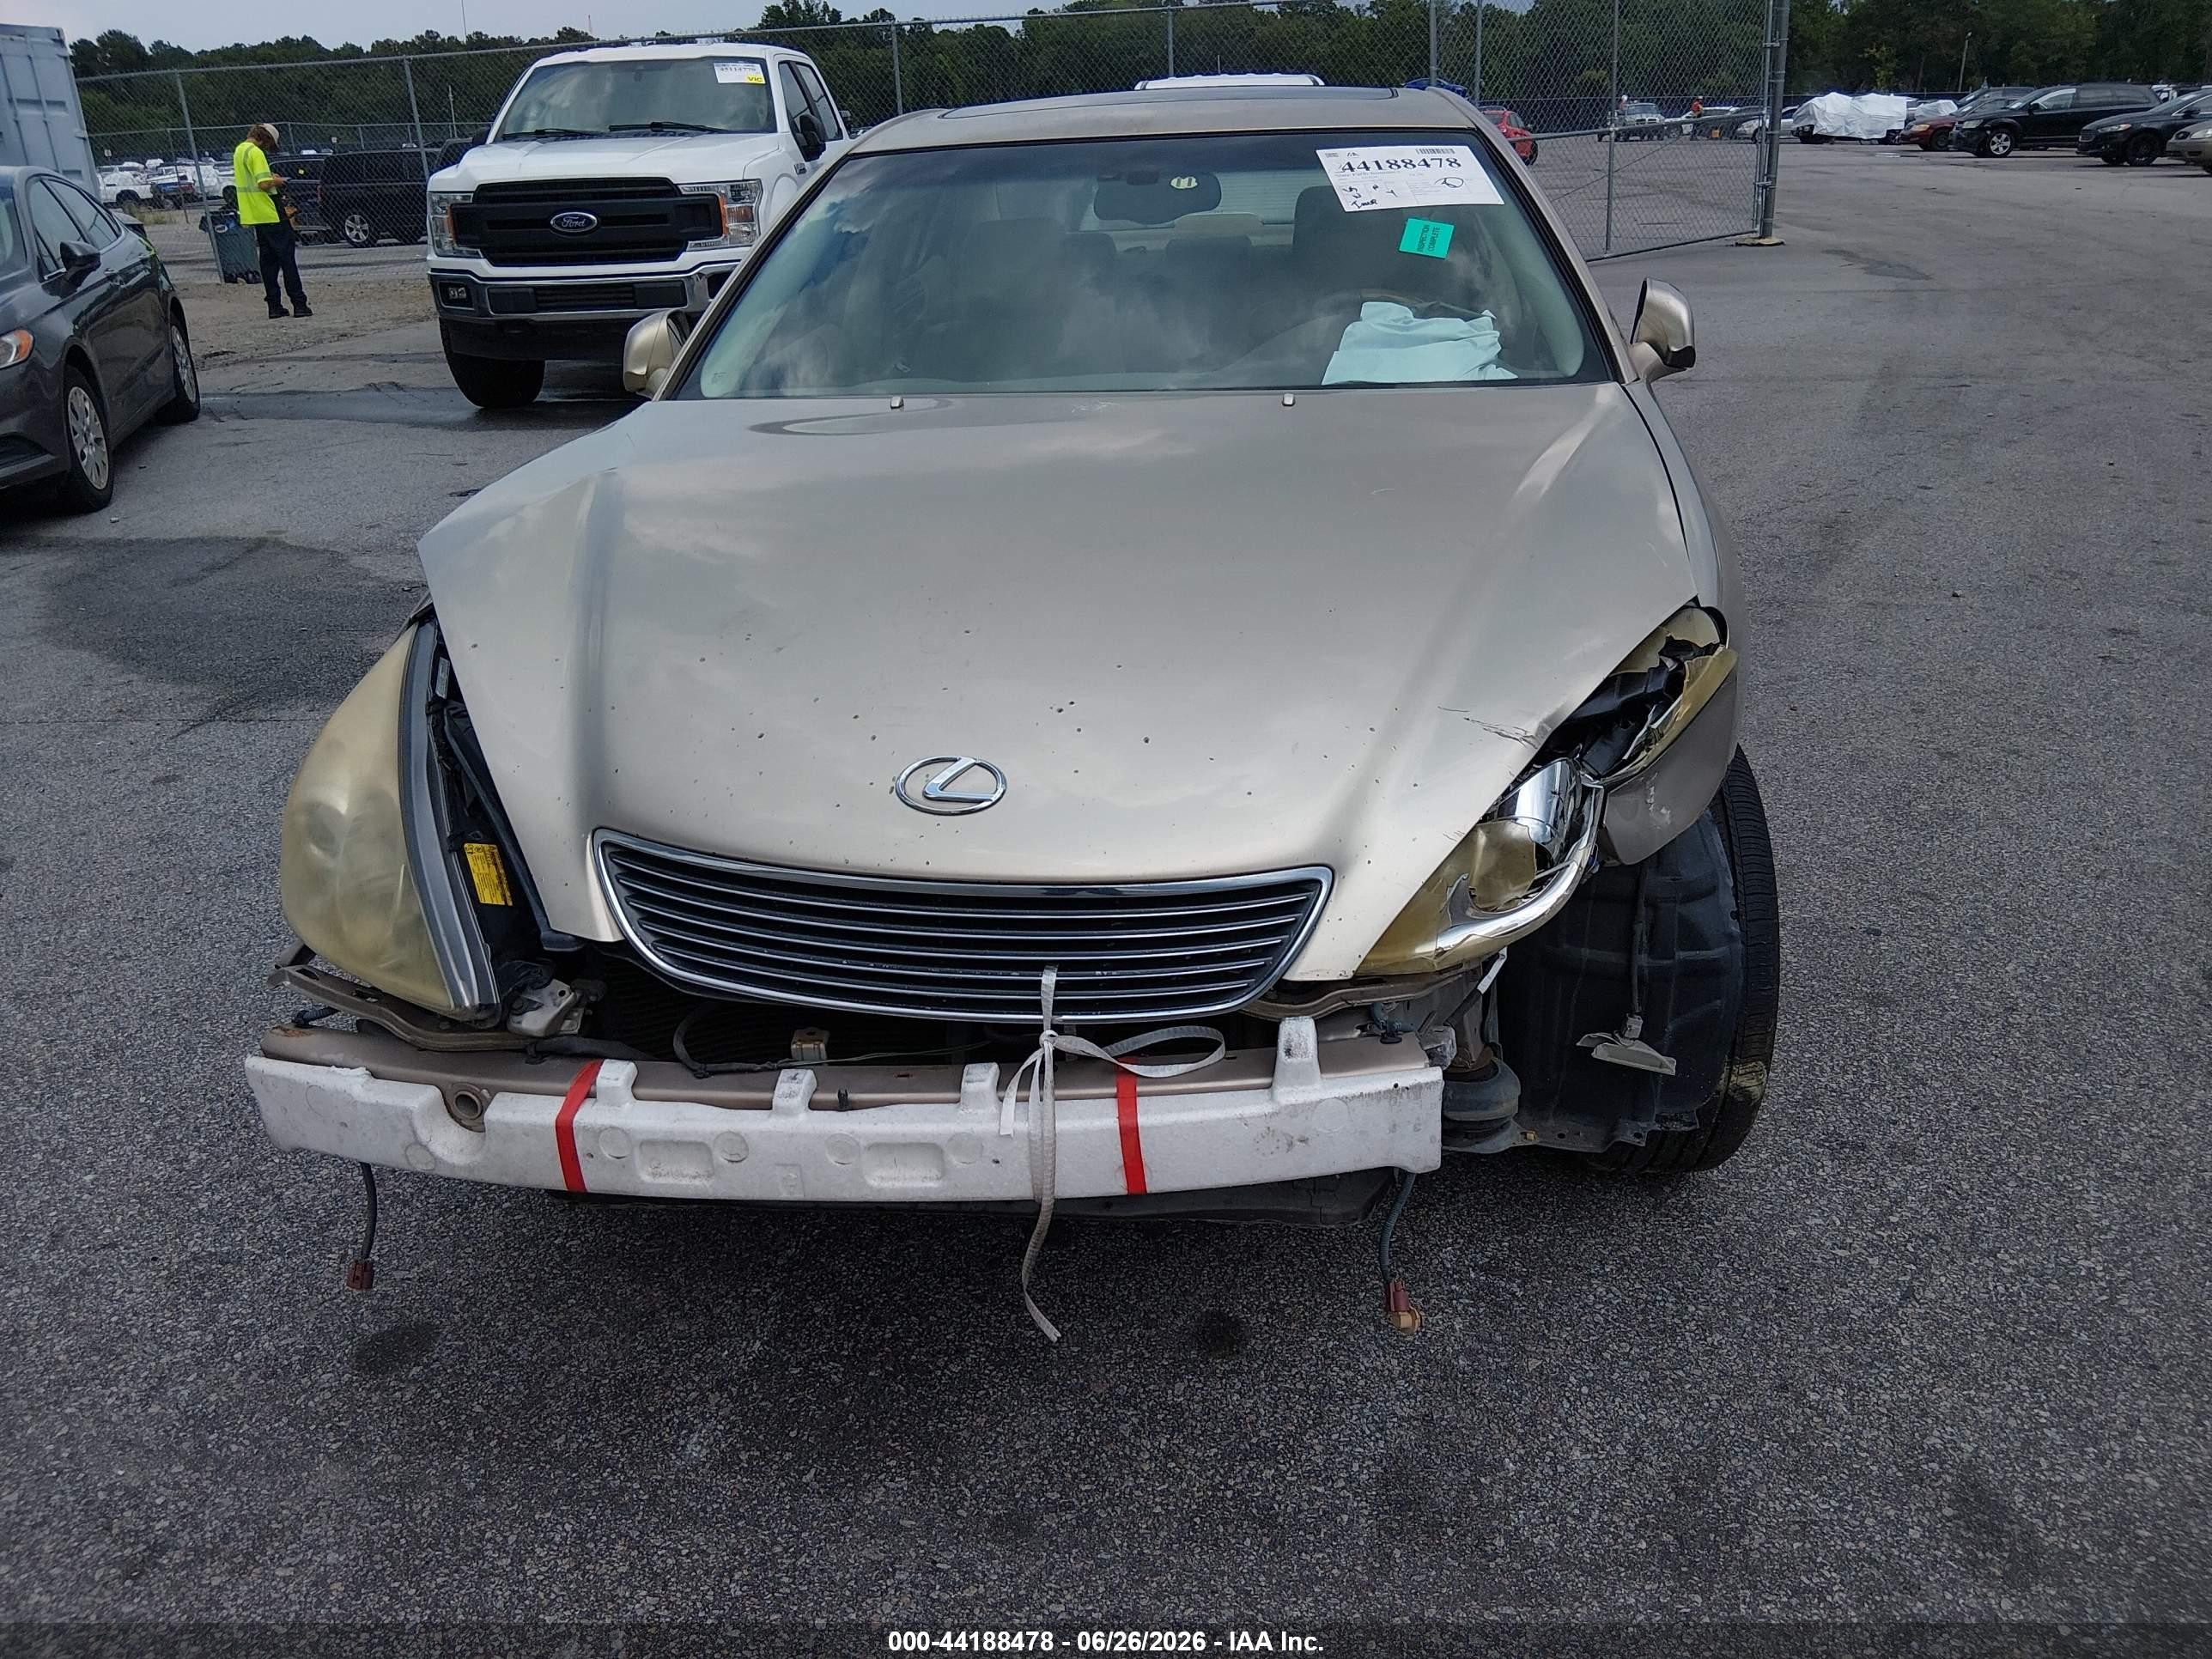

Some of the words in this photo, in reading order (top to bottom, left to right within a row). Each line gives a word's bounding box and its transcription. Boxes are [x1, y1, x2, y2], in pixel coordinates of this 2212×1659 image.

[1341, 157, 1462, 173] 44188478
[562, 216, 586, 228] Ford
[1417, 224, 1430, 252] INSPECTION
[1428, 226, 1441, 252] COMPLETE
